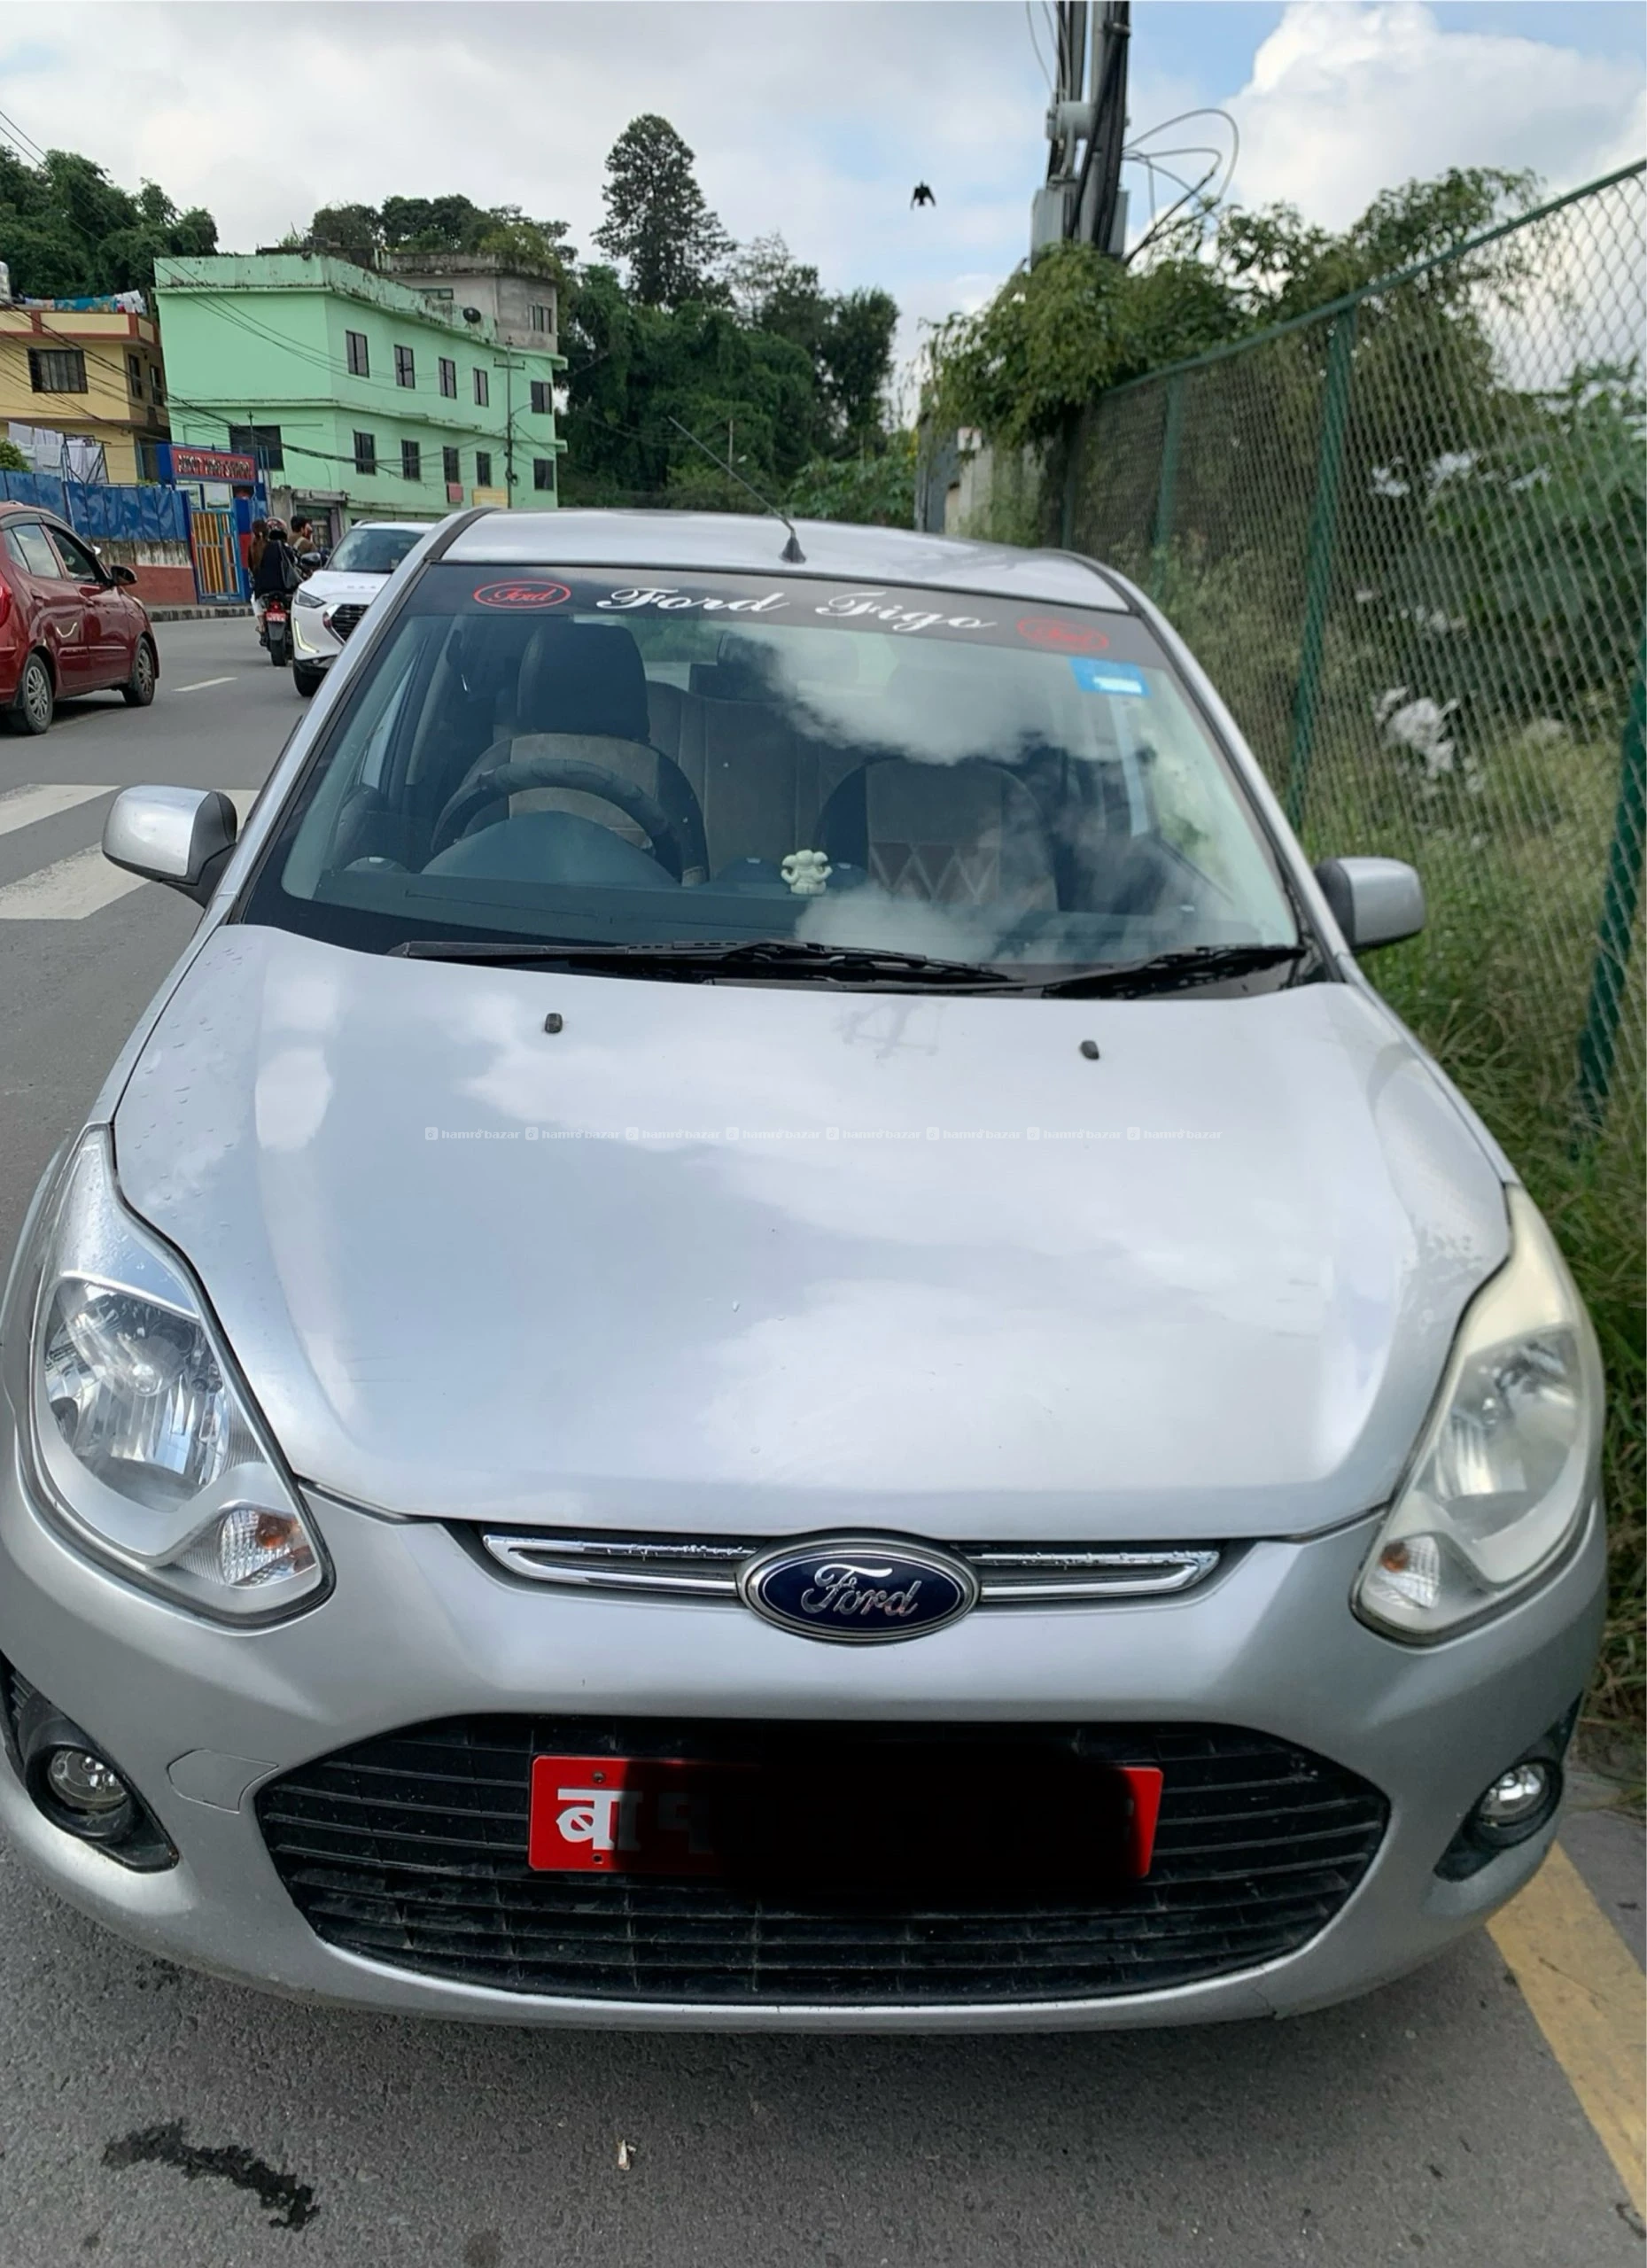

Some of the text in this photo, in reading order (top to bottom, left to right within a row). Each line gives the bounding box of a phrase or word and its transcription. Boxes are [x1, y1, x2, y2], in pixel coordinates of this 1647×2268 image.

[488, 586, 557, 602] Ford
[596, 587, 998, 632] Ford Figo
[800, 1563, 922, 1617] Ford
